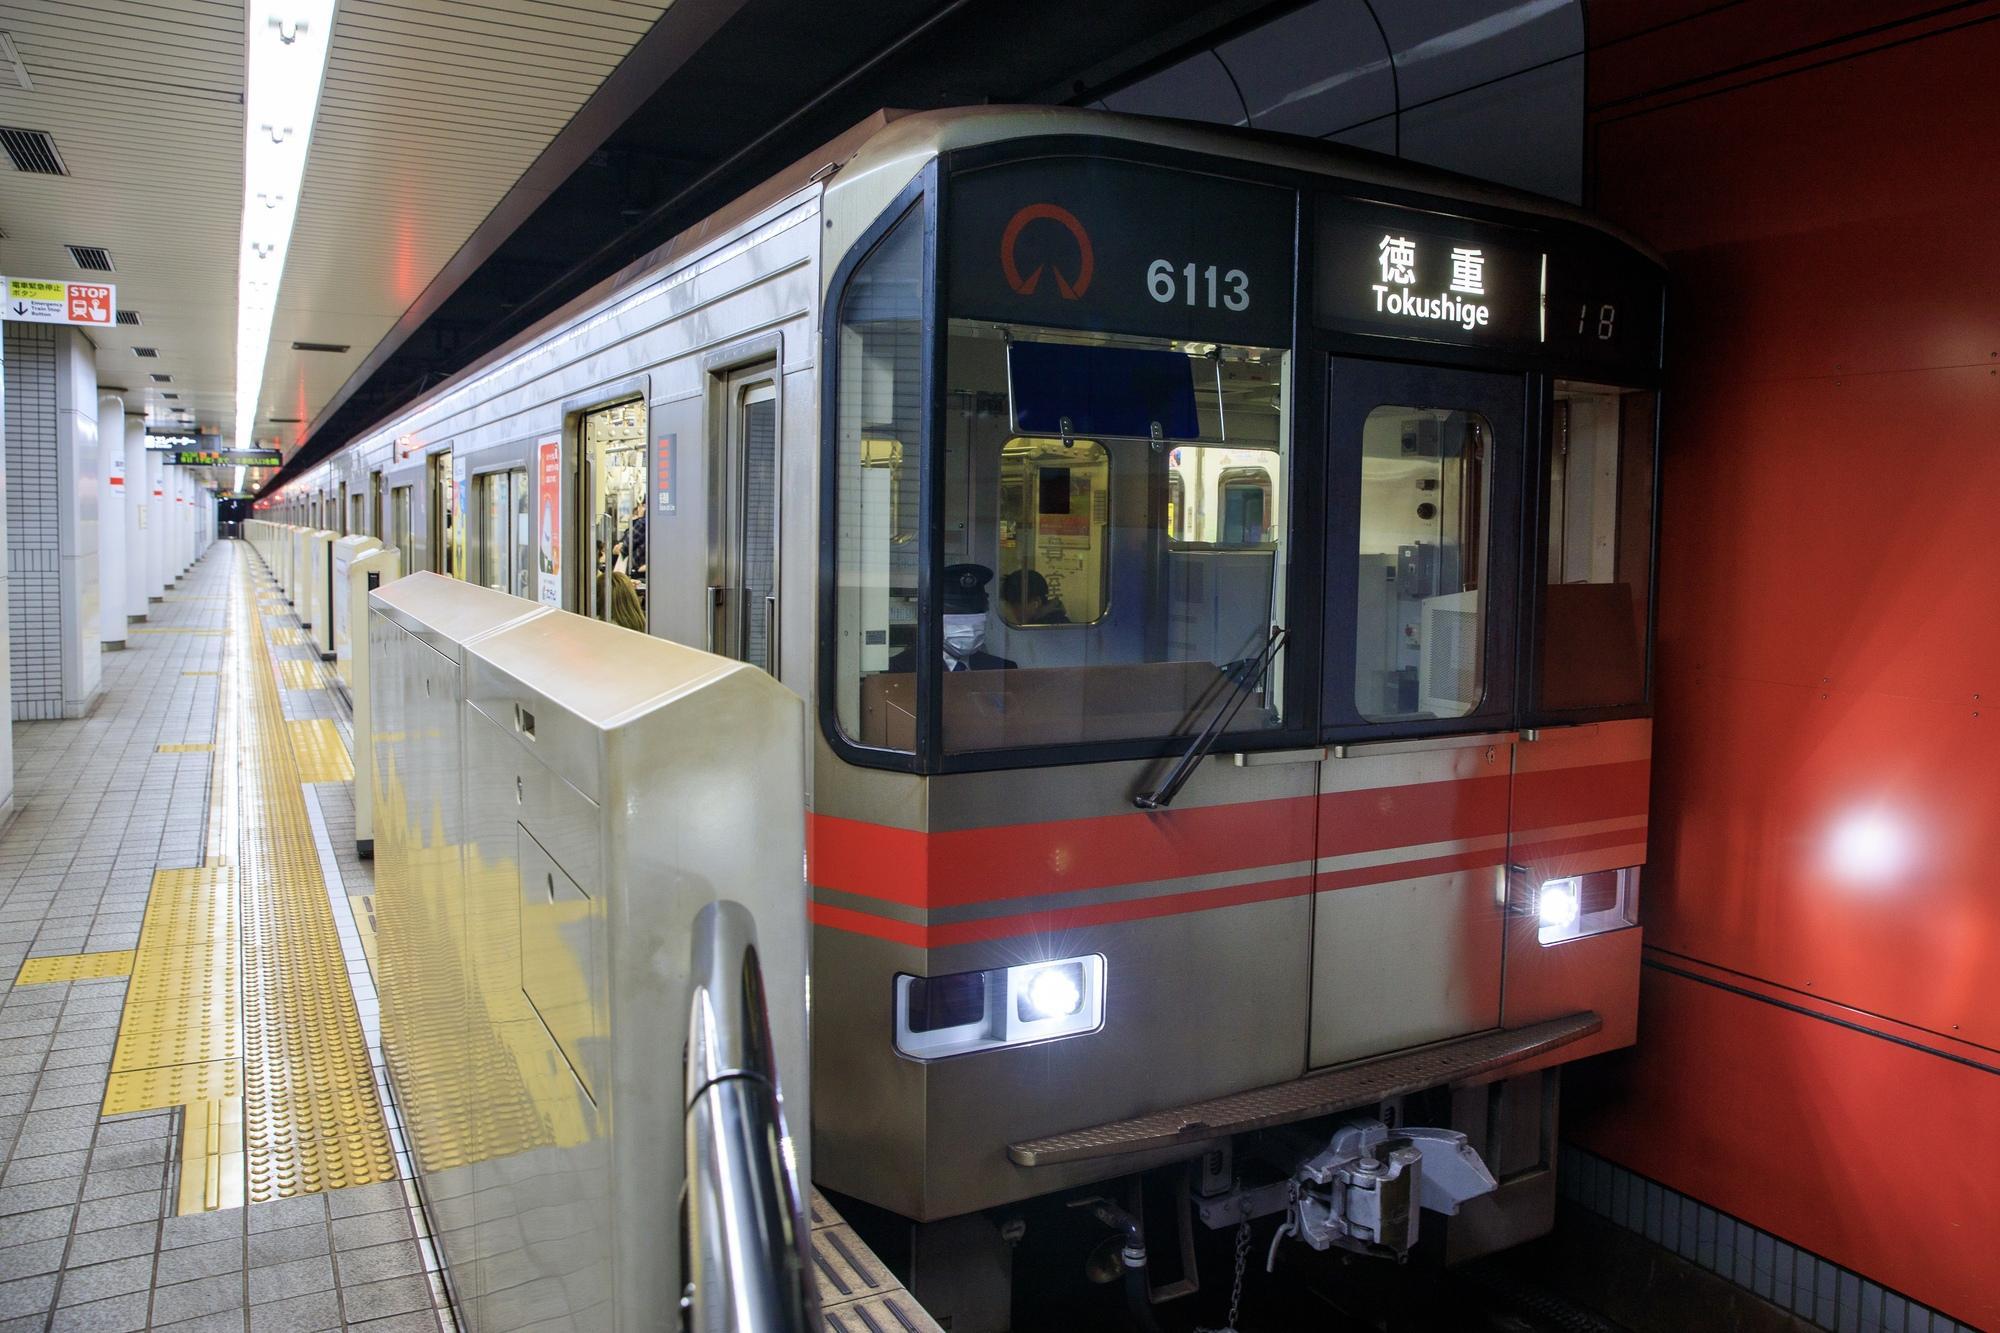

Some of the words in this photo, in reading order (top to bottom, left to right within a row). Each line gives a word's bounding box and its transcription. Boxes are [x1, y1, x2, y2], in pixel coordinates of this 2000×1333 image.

[1147, 259, 1250, 312] 6113
[1379, 234, 1485, 295] 徳重
[70, 287, 108, 298] STOP
[1372, 285, 1489, 330] Tokushige
